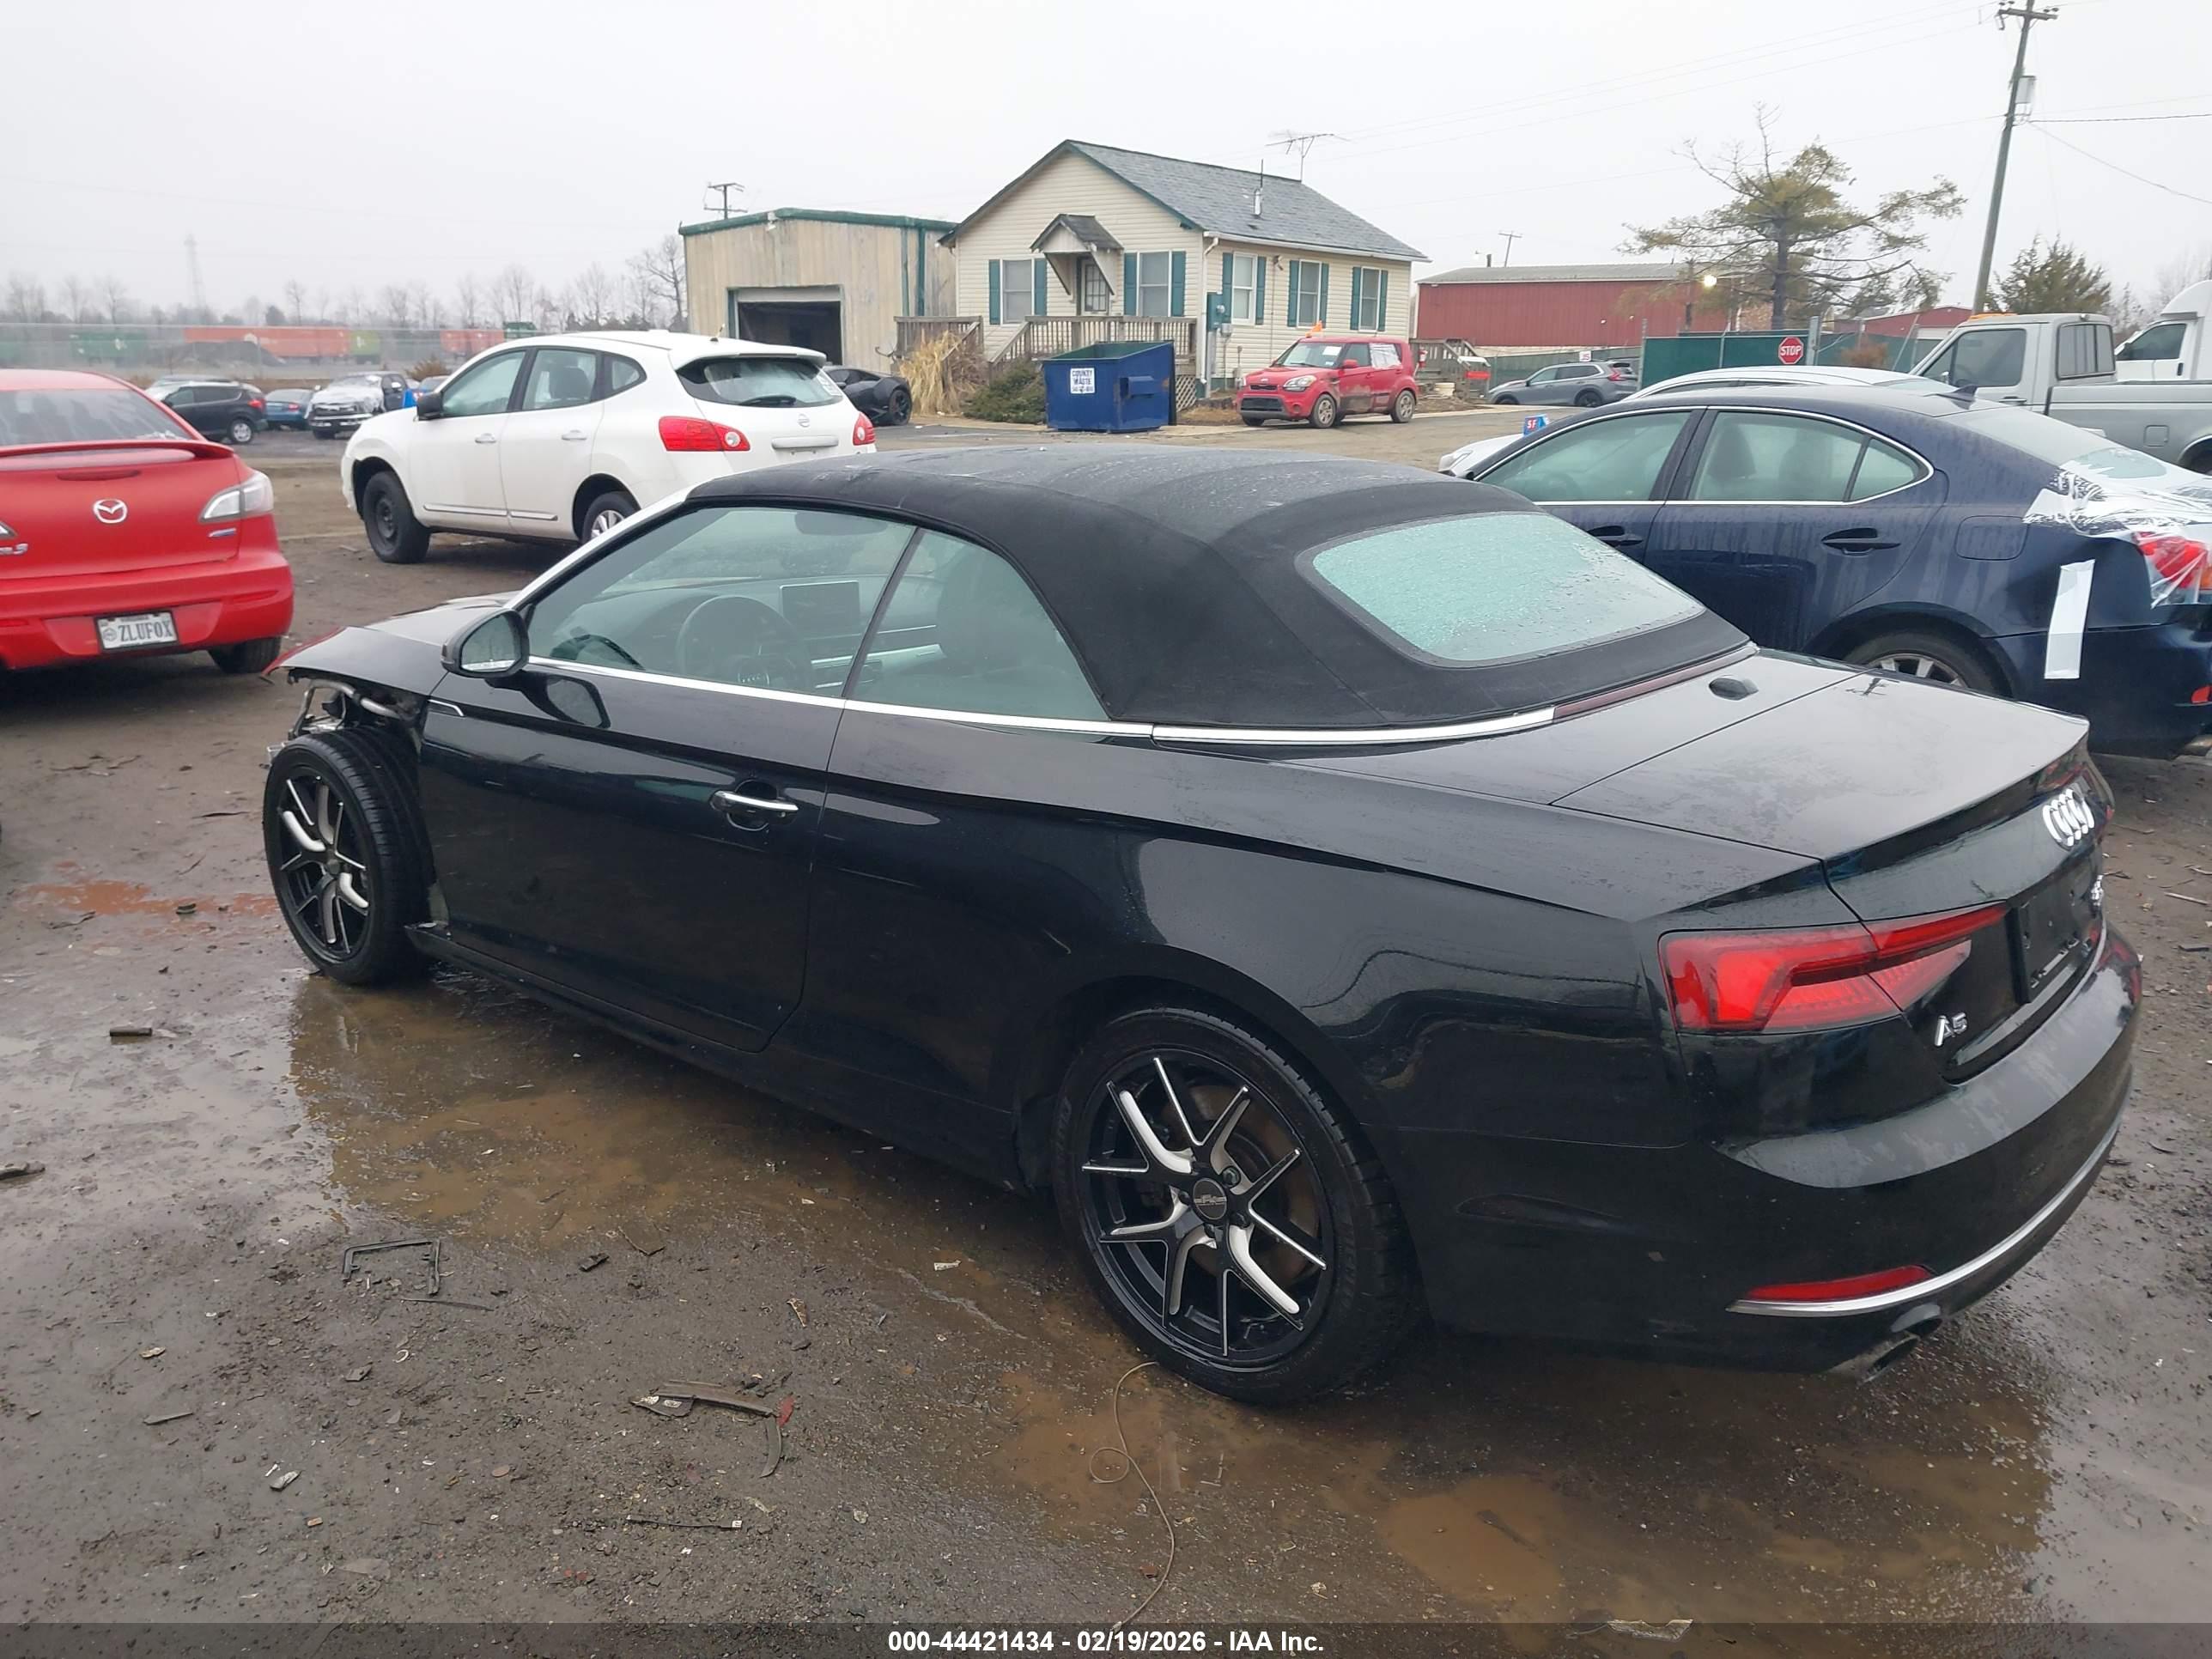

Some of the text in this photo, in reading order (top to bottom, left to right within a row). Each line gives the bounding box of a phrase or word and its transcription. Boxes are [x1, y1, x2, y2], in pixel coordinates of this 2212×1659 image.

[1780, 345, 1802, 356] STOP
[118, 620, 173, 641] ZLUFOX
[1935, 1012, 1967, 1046] A5
